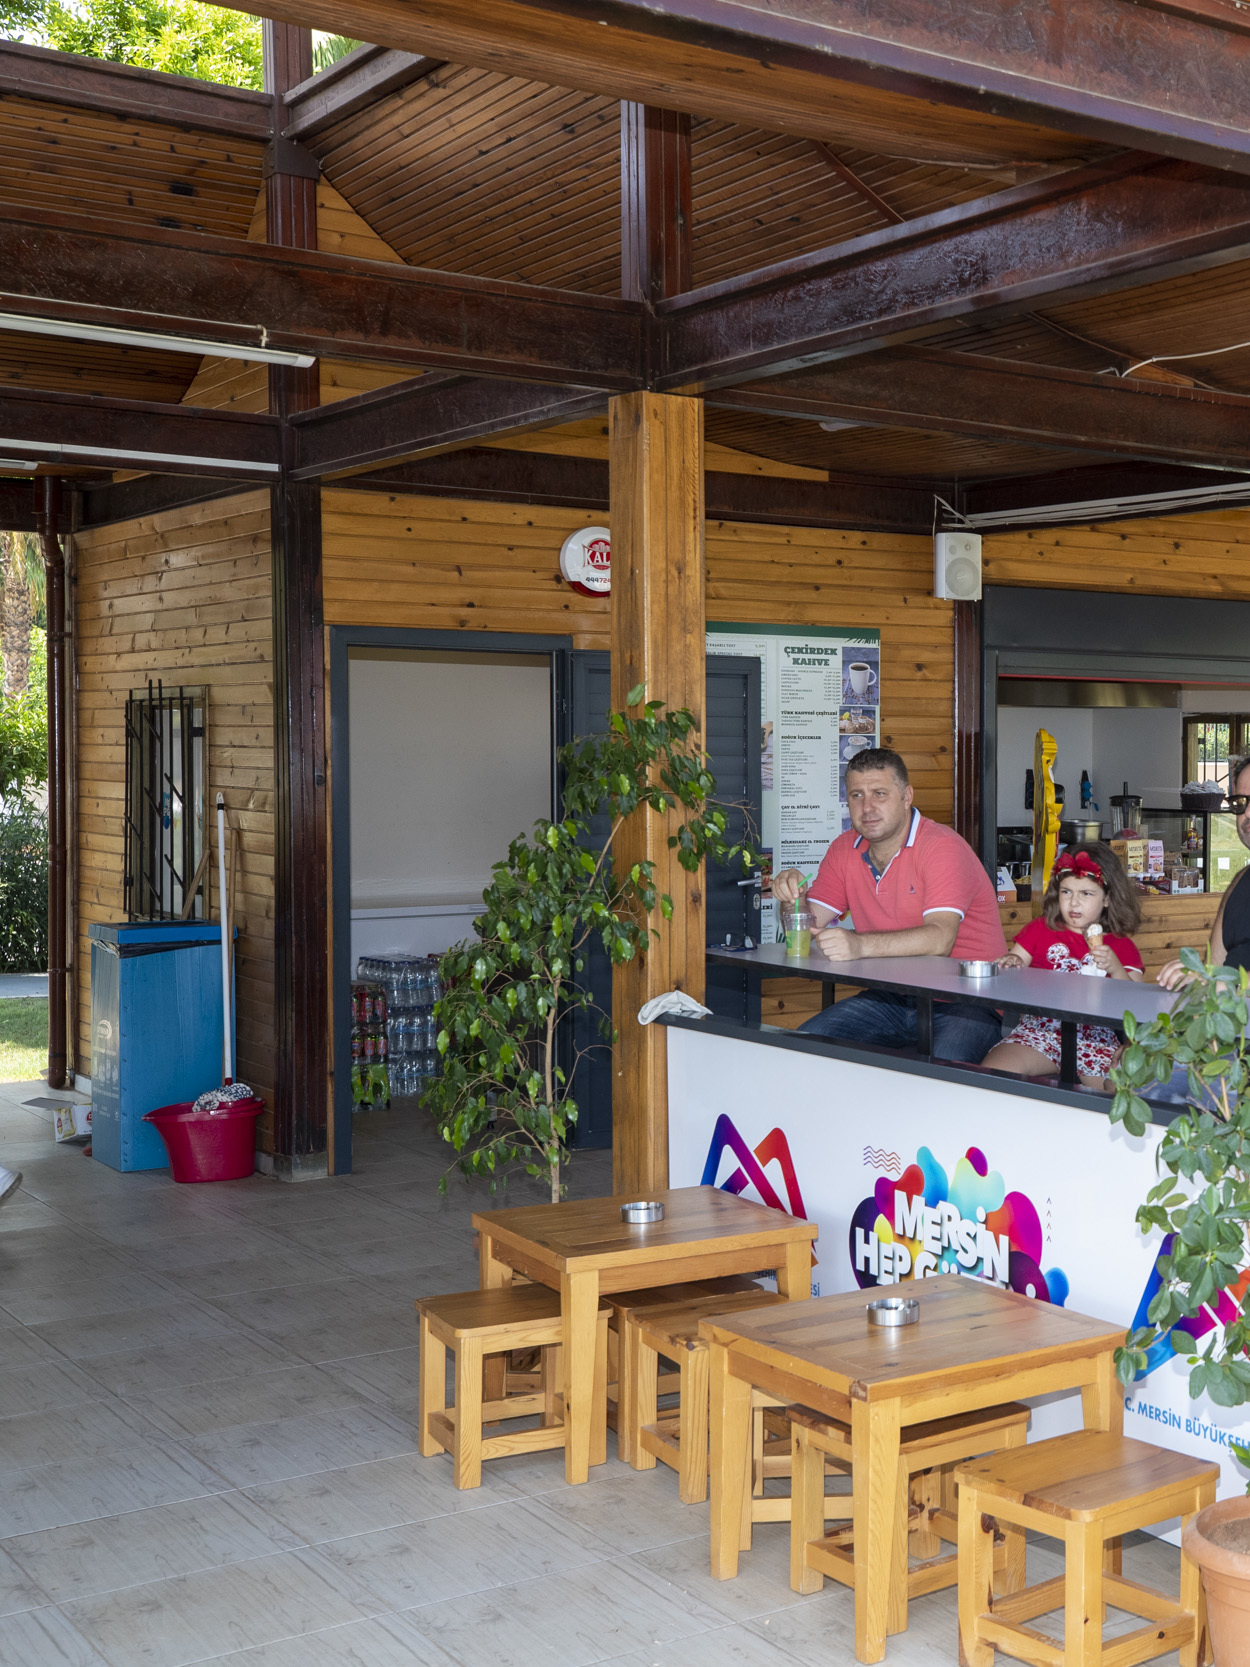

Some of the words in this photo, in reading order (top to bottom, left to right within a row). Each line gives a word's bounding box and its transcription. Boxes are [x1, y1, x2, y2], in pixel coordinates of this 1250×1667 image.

[783, 644, 838, 658] ÇEKİRDEK
[792, 657, 830, 666] KAHVE
[855, 1227, 912, 1286] HEP
[894, 1189, 1010, 1284] MERSİN
[1137, 1401, 1182, 1430] MERSİN
[1185, 1416, 1250, 1453] BÜYÜKŞEH
